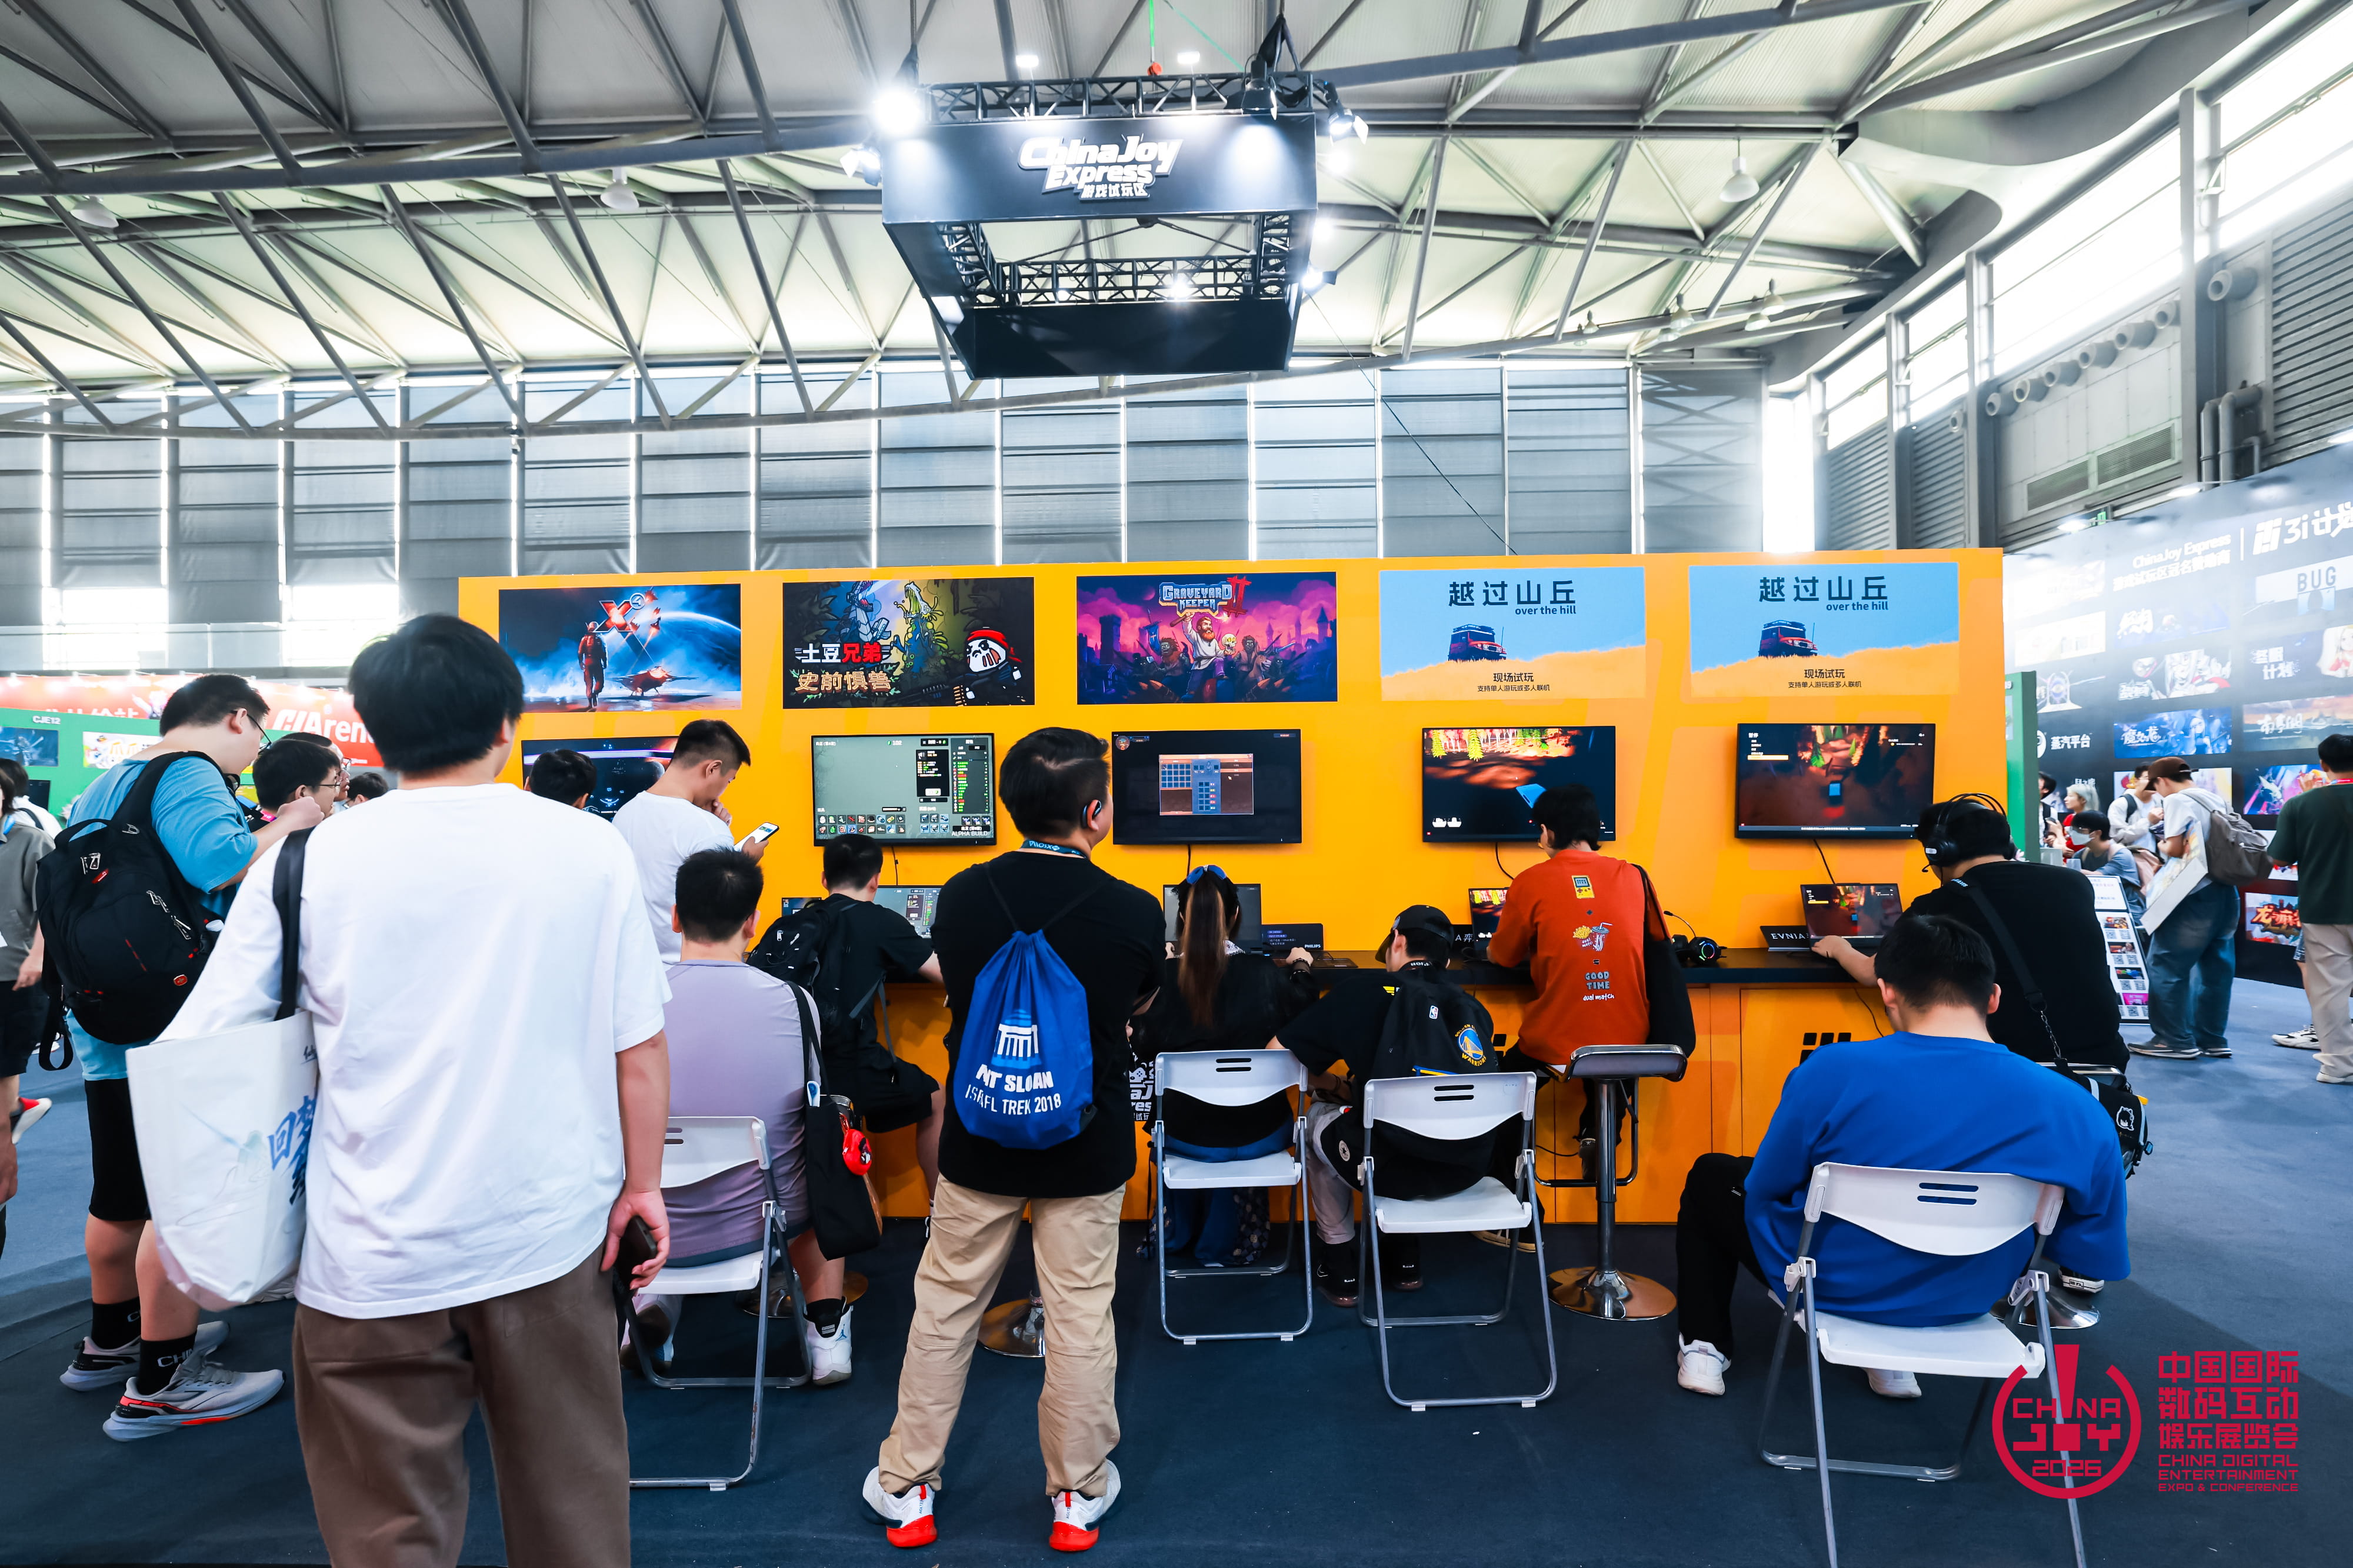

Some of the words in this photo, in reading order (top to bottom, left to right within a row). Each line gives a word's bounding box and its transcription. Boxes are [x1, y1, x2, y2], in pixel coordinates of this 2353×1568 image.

[1019, 135, 1181, 173] ChinaJoy
[1045, 164, 1152, 189] Express
[1081, 182, 1148, 198] 游戏试玩区
[2132, 548, 2182, 569] ChinaJoy
[2184, 534, 2231, 555] Express
[2297, 566, 2336, 592] BUG
[1162, 584, 1232, 601] GRAVEYARD
[1448, 580, 1576, 606] 越过山丘
[1759, 576, 1887, 602] 越过山丘
[1179, 599, 1215, 610] KEEPER
[1540, 606, 1557, 614] the
[1560, 605, 1577, 614] hill
[1852, 602, 1869, 610] the
[1871, 601, 1888, 610] hill
[801, 642, 882, 663] 土豆兄弟
[1493, 672, 1534, 682] 现场试玩
[1804, 669, 1845, 679] 现场试玩
[2262, 661, 2297, 680] 计划
[795, 670, 892, 692] 史前惧兽
[32, 715, 61, 725] CJE12
[2050, 733, 2091, 750] 蒸汽平台
[1585, 971, 1609, 980] GOOD
[1587, 981, 1610, 990] TIME
[1595, 993, 1615, 1001] match
[1462, 1053, 1487, 1066] WARRIORS
[1004, 1071, 1054, 1093] SLOAN
[1002, 1099, 1031, 1115] TREK
[1034, 1093, 1061, 1113] 2018
